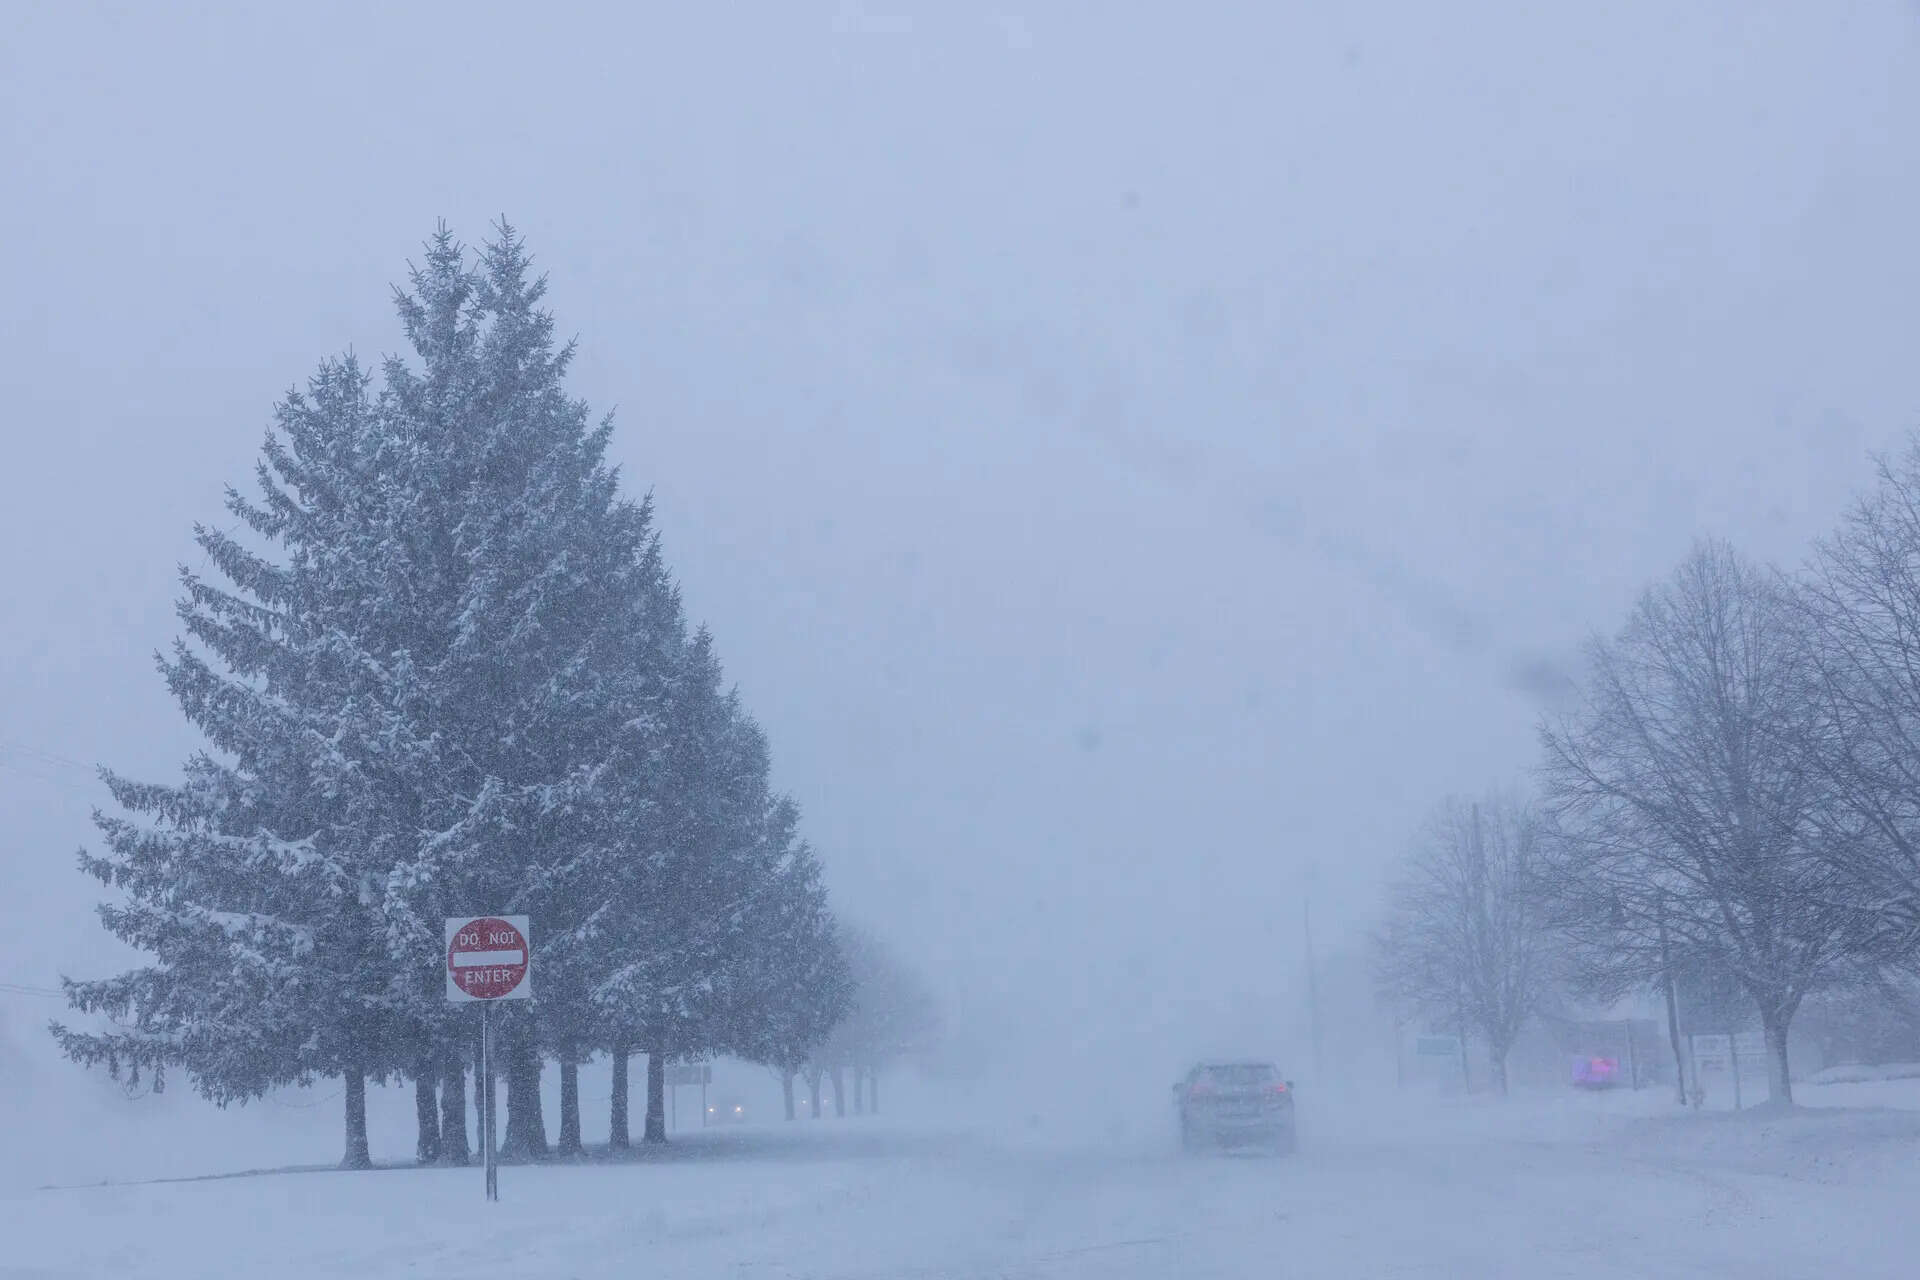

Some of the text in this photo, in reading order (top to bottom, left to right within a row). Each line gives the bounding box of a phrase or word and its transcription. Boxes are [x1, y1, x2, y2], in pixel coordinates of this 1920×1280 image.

[459, 931, 516, 946] DO NOT
[465, 969, 511, 984] ENTER
